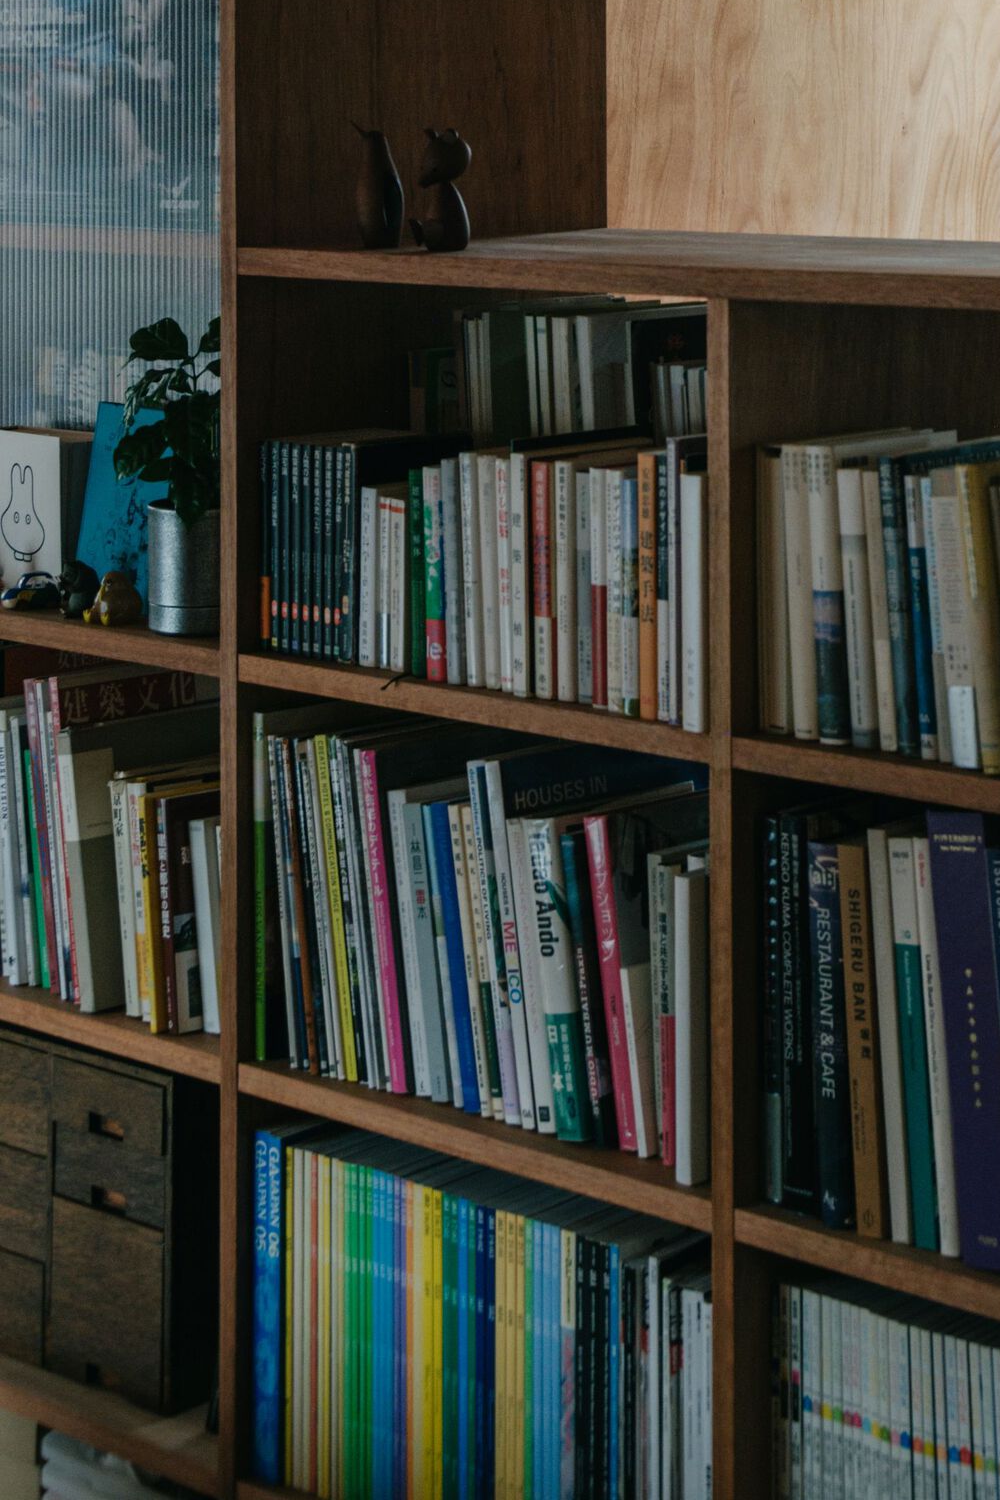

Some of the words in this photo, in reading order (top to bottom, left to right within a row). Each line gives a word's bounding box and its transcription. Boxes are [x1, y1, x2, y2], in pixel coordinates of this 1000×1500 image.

[512, 512, 524, 674] 建築と植物
[641, 531, 654, 624] 建築手法
[63, 671, 198, 725] 建築文化
[318, 740, 327, 780] CREATIVE
[326, 819, 337, 887] COMMUNICATION
[515, 779, 585, 810] HOUSES
[590, 774, 608, 794] IN
[528, 829, 551, 892] Tadao
[781, 831, 791, 879] KENGO
[476, 837, 487, 887] POLITICS
[484, 904, 493, 940] LIVING
[781, 882, 793, 929] KUMA
[535, 901, 559, 957] Ando
[848, 888, 864, 973] SHIGERU
[782, 931, 794, 1002] COMPLETE
[816, 906, 835, 1030] RESTAURANT
[851, 982, 866, 1023] BAN
[783, 1004, 794, 1060] WORKS
[820, 1032, 835, 1046] &
[256, 1140, 267, 1168] GA
[269, 1146, 280, 1175] GA
[258, 1173, 267, 1220] JAPAN
[270, 1177, 280, 1229] JAPAN
[256, 1225, 267, 1252] 05
[269, 1232, 280, 1258] 06
